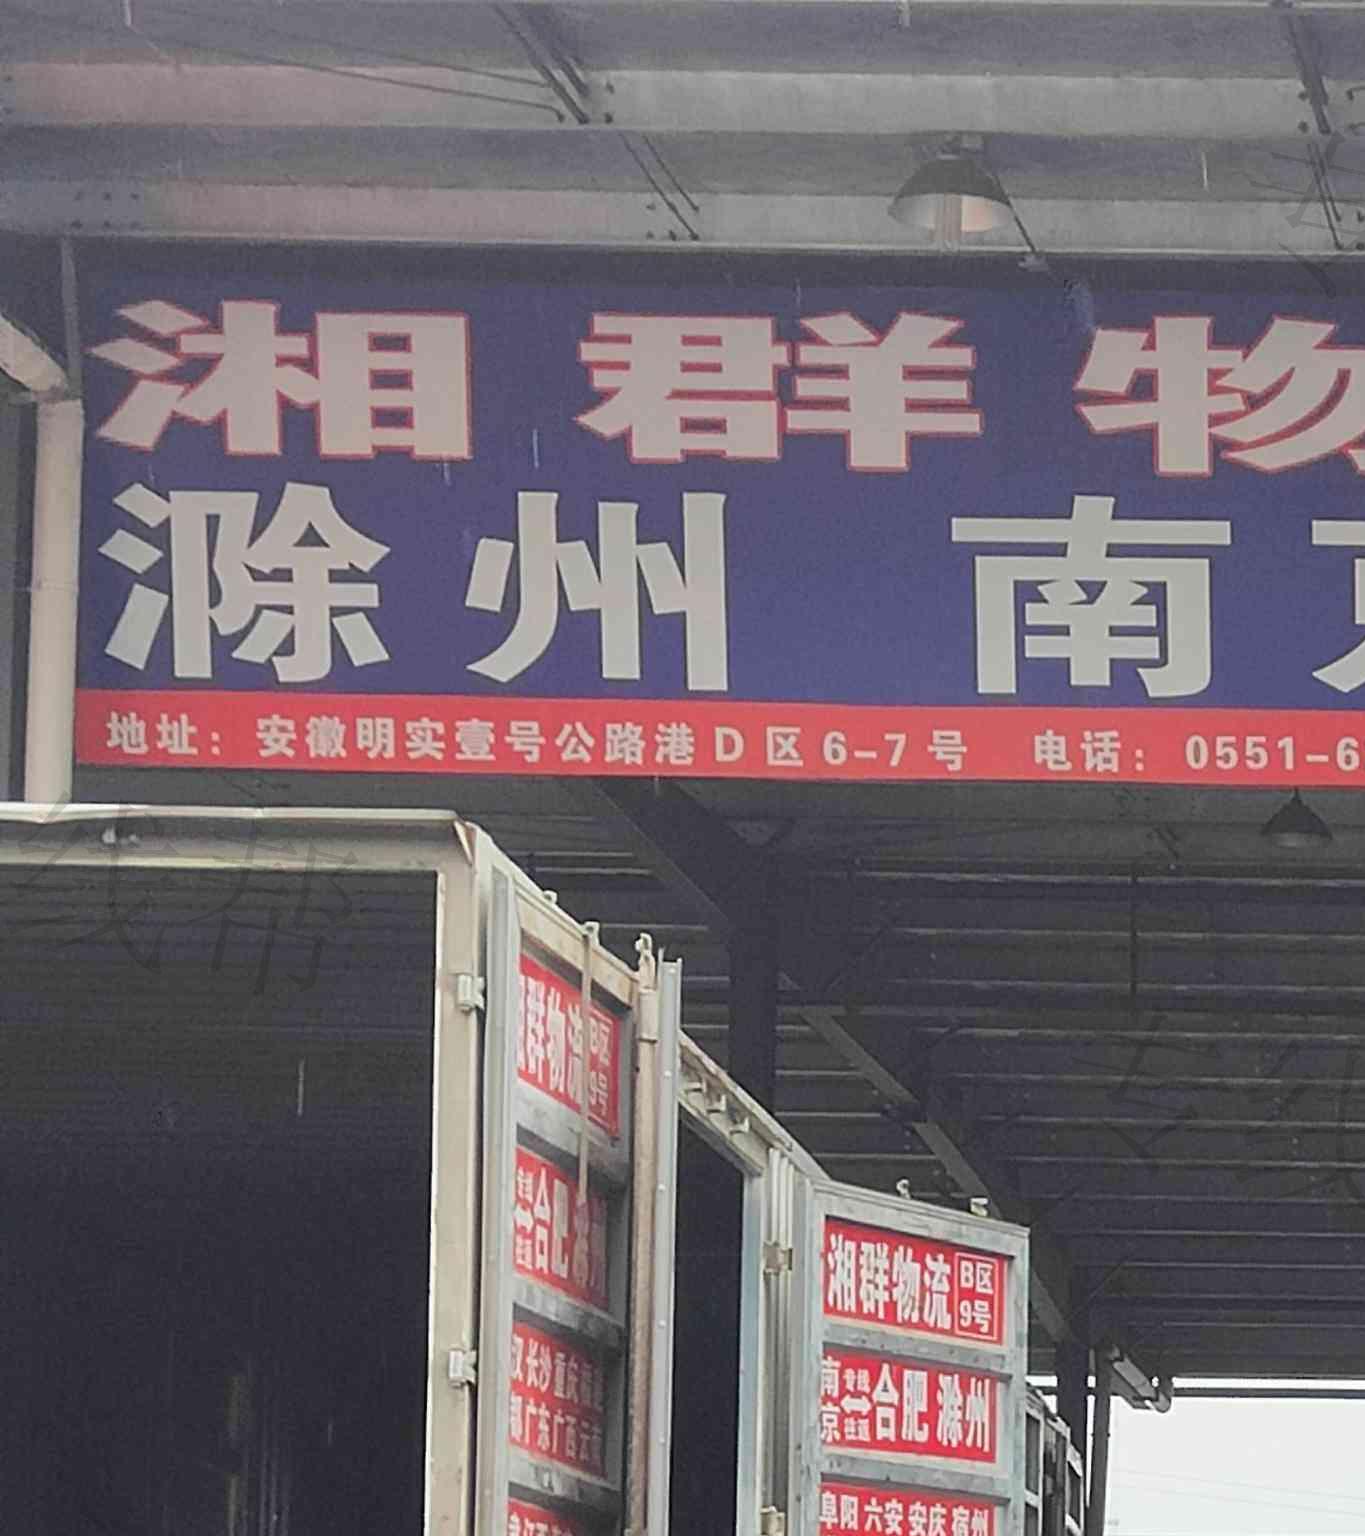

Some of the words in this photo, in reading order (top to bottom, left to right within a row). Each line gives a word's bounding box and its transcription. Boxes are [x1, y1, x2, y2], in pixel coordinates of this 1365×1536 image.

[97, 481, 730, 692] 滁州
[827, 1232, 952, 1330] 湘群物流
[958, 1259, 994, 1295] B区
[958, 1298, 994, 1334] 9号
[872, 1362, 930, 1443] 合肥
[936, 1372, 992, 1452] 滁州
[818, 1491, 859, 1531] 阜阳
[863, 1496, 904, 1536] 六安
